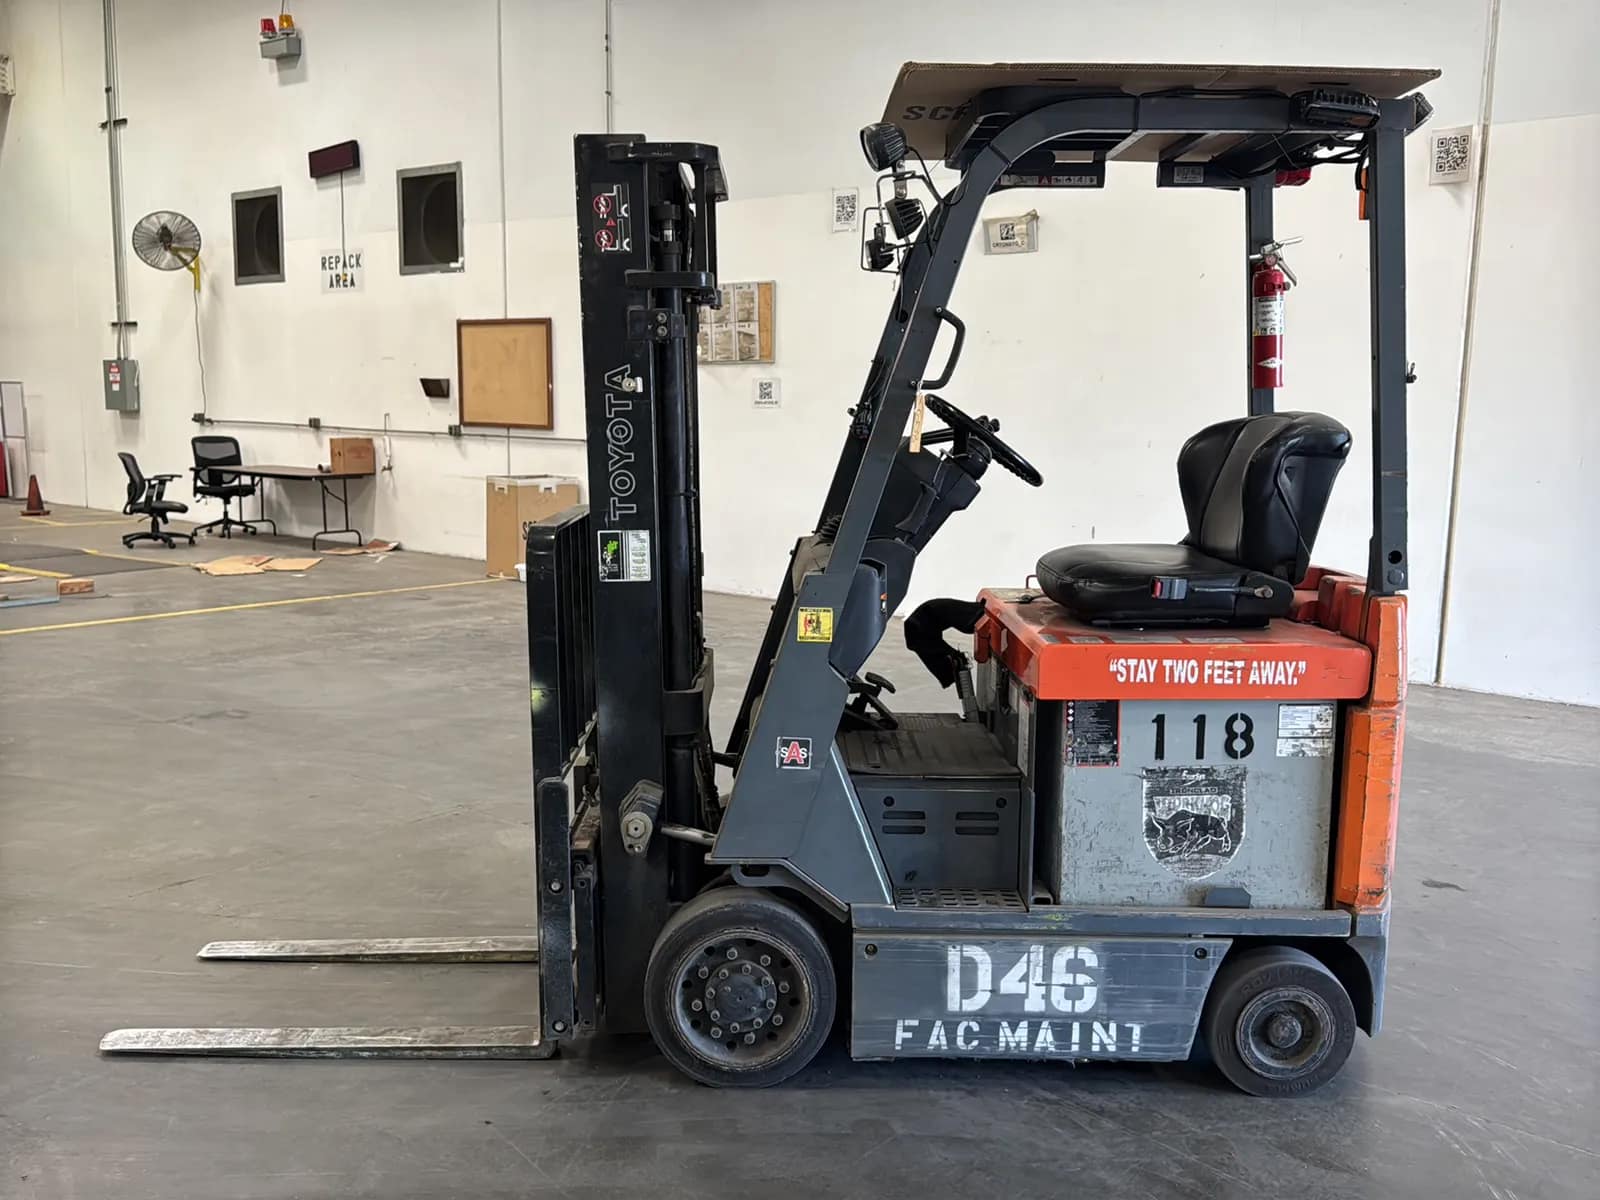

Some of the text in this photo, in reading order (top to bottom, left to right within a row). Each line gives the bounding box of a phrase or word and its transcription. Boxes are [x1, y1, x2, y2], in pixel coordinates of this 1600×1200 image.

[321, 252, 361, 271] REPACK
[329, 272, 355, 288] AREA
[604, 363, 637, 521] TOYOTA
[1162, 659, 1199, 684] TWO
[1204, 660, 1245, 685] FEET
[1151, 712, 1255, 760] 118
[947, 945, 1099, 1013] D46
[895, 1020, 1144, 1052] FAC MAINT
